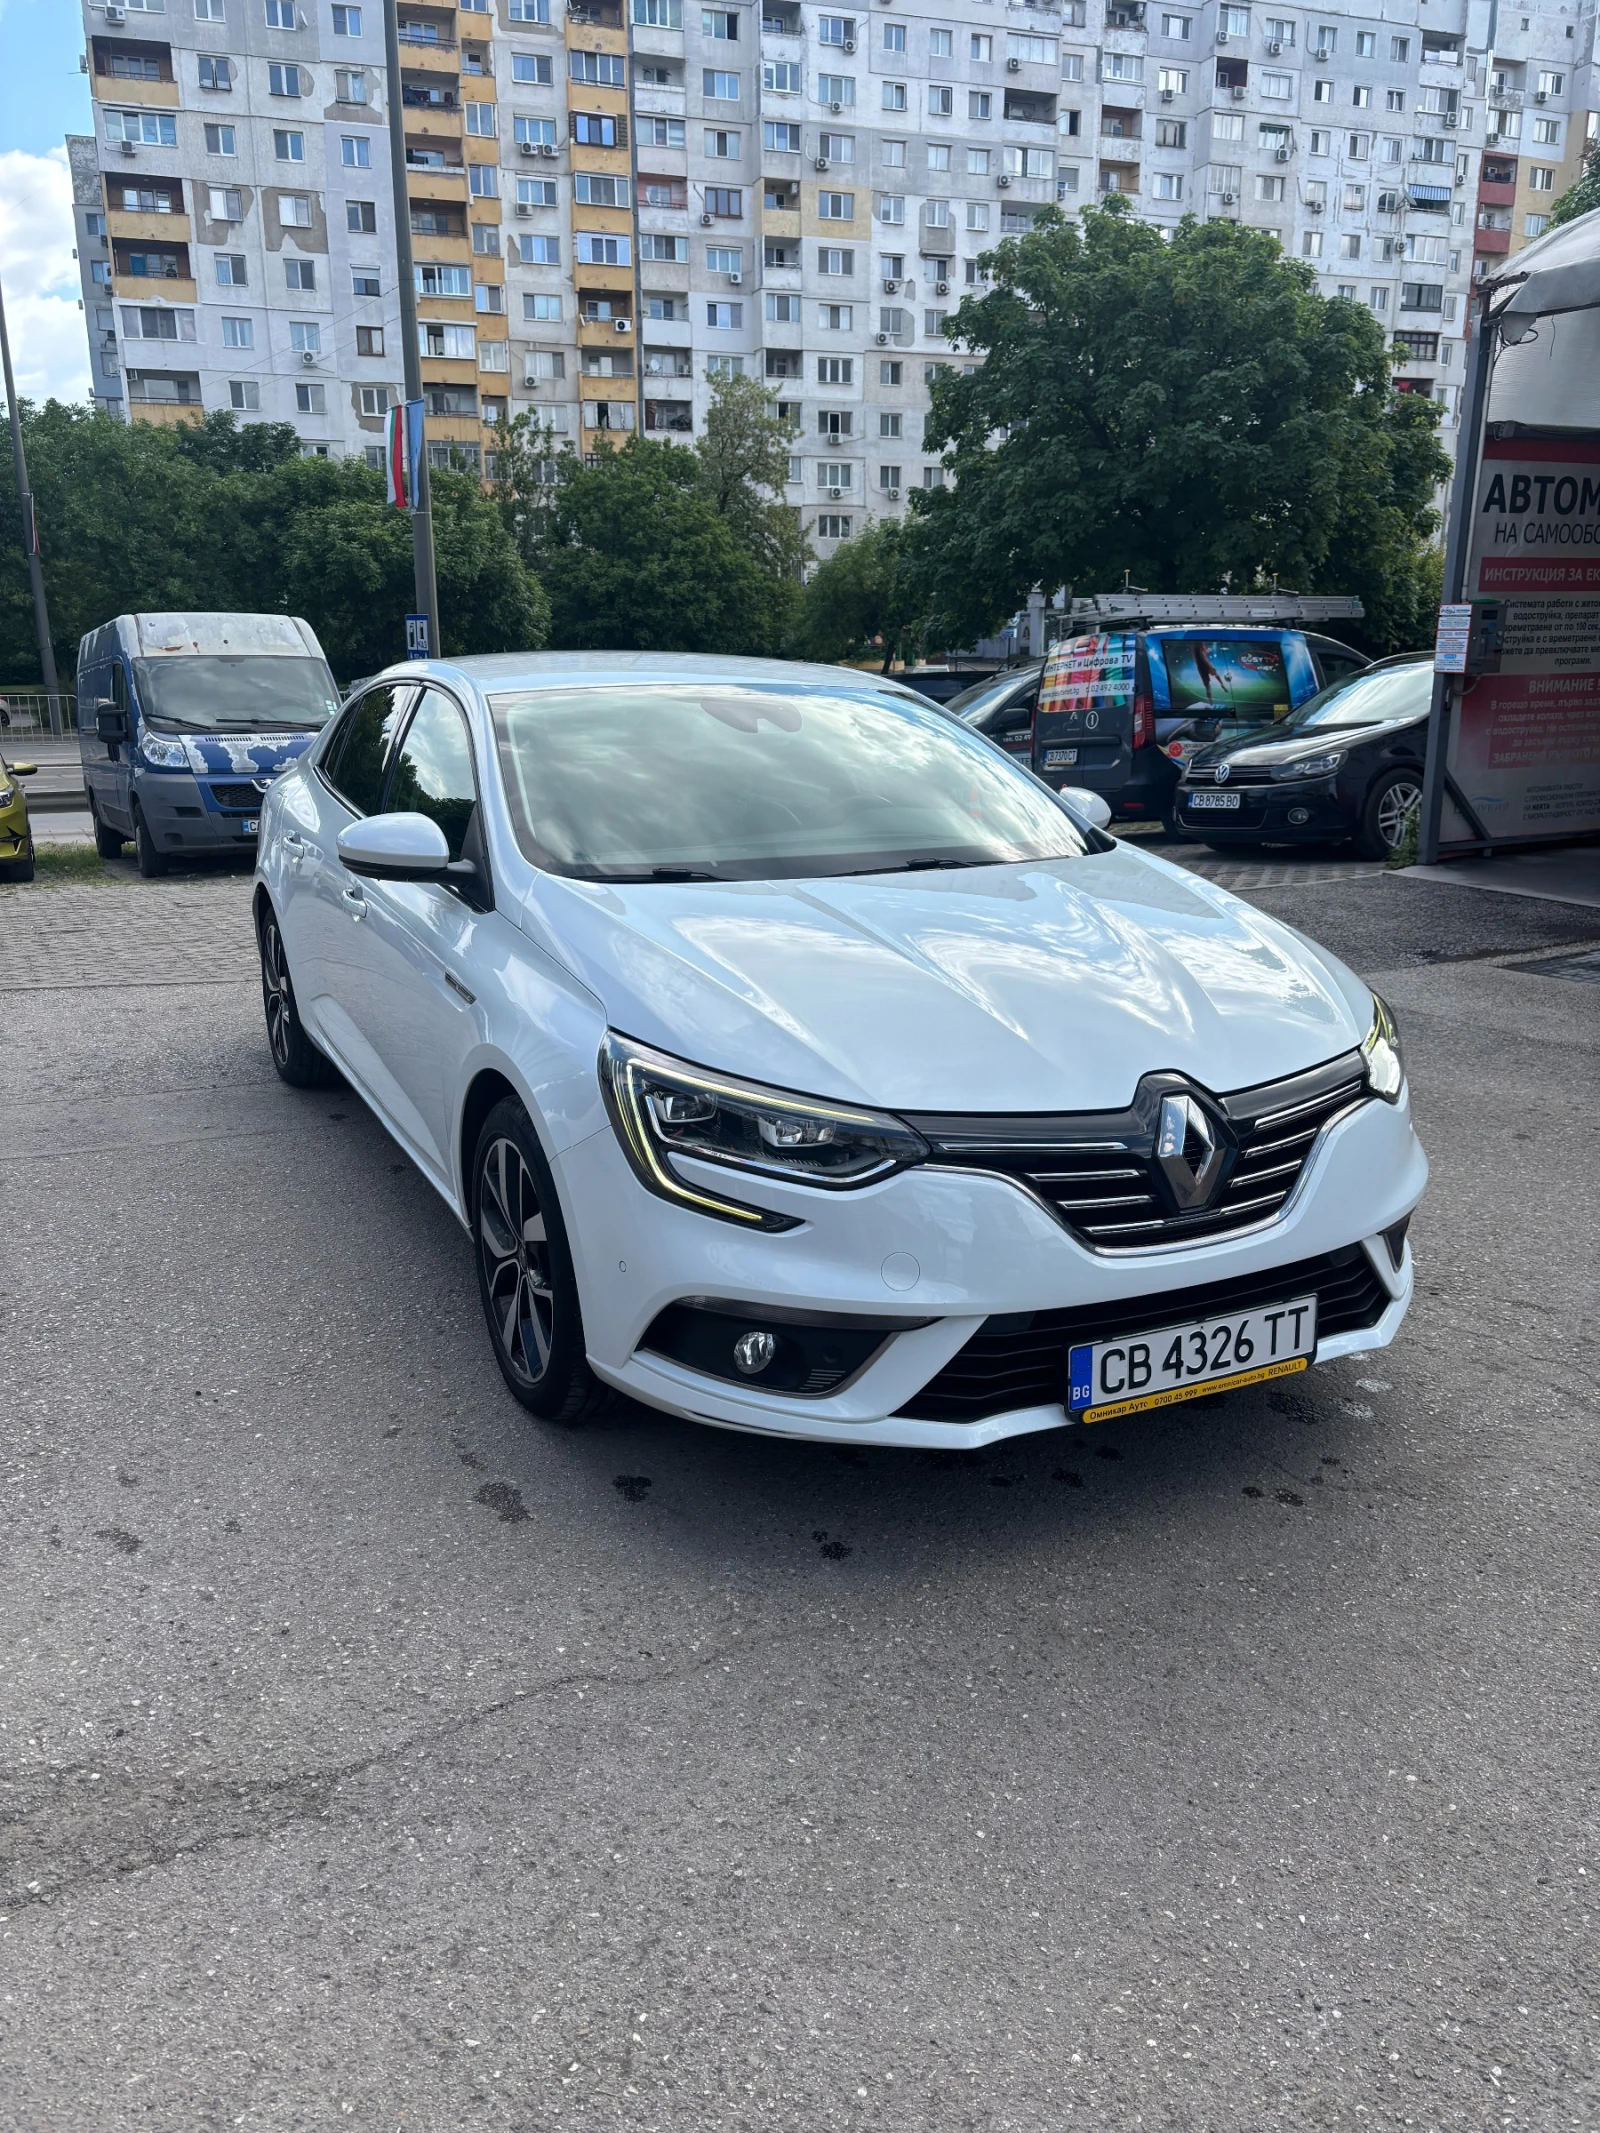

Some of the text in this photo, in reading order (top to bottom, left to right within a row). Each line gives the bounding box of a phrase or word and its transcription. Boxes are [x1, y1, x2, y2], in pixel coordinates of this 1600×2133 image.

[1494, 522, 1517, 543] НА
[1484, 567, 1565, 583] ИНСТРУКЦИЯ
[1568, 568, 1582, 581] ЗА
[1505, 599, 1545, 608] Системата
[1547, 599, 1573, 610] работи
[1045, 659, 1077, 673] ИНТЕРНЕТ
[1083, 657, 1119, 668] Цифрова
[1121, 654, 1133, 664] TV
[1091, 684, 1100, 692] 02
[1100, 684, 1112, 692] 492
[1113, 682, 1130, 691] 4000
[1529, 678, 1595, 693] ВНИМАНИЕ
[1193, 795, 1204, 806] CB
[1205, 795, 1226, 807] 8785
[1100, 1305, 1309, 1395] CB 4326 TT
[1073, 1385, 1090, 1400] BG
[1090, 1406, 1127, 1420] Омникар
[1154, 1396, 1172, 1405] 0700
[1174, 1393, 1182, 1401] 45
[1184, 1389, 1198, 1398] 999
[1202, 1373, 1265, 1393] www.omnicar-auto.bg
[1268, 1361, 1302, 1376] RENAULT
